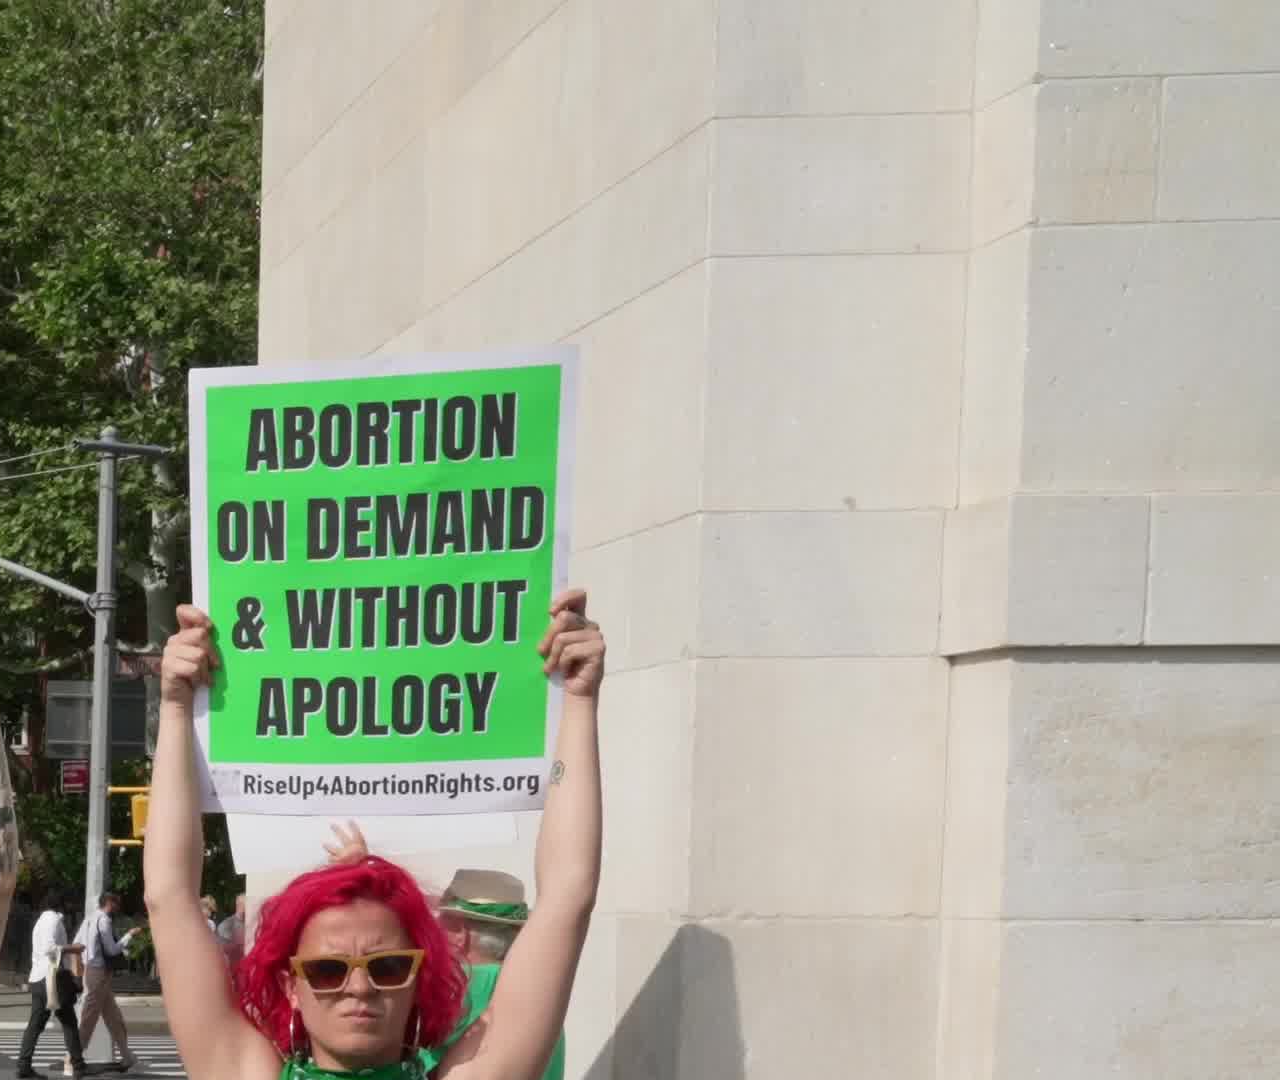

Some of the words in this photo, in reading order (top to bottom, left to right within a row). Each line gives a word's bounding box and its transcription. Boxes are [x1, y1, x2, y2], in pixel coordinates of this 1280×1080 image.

[245, 392, 517, 473] ABORTION
[217, 500, 286, 563] ON
[306, 485, 546, 561] DEMAND
[232, 597, 268, 651] &
[286, 579, 528, 650] WITHOUT
[255, 671, 498, 738] APOLOGY
[243, 773, 540, 798] RiseUp4AbortionRights.org
